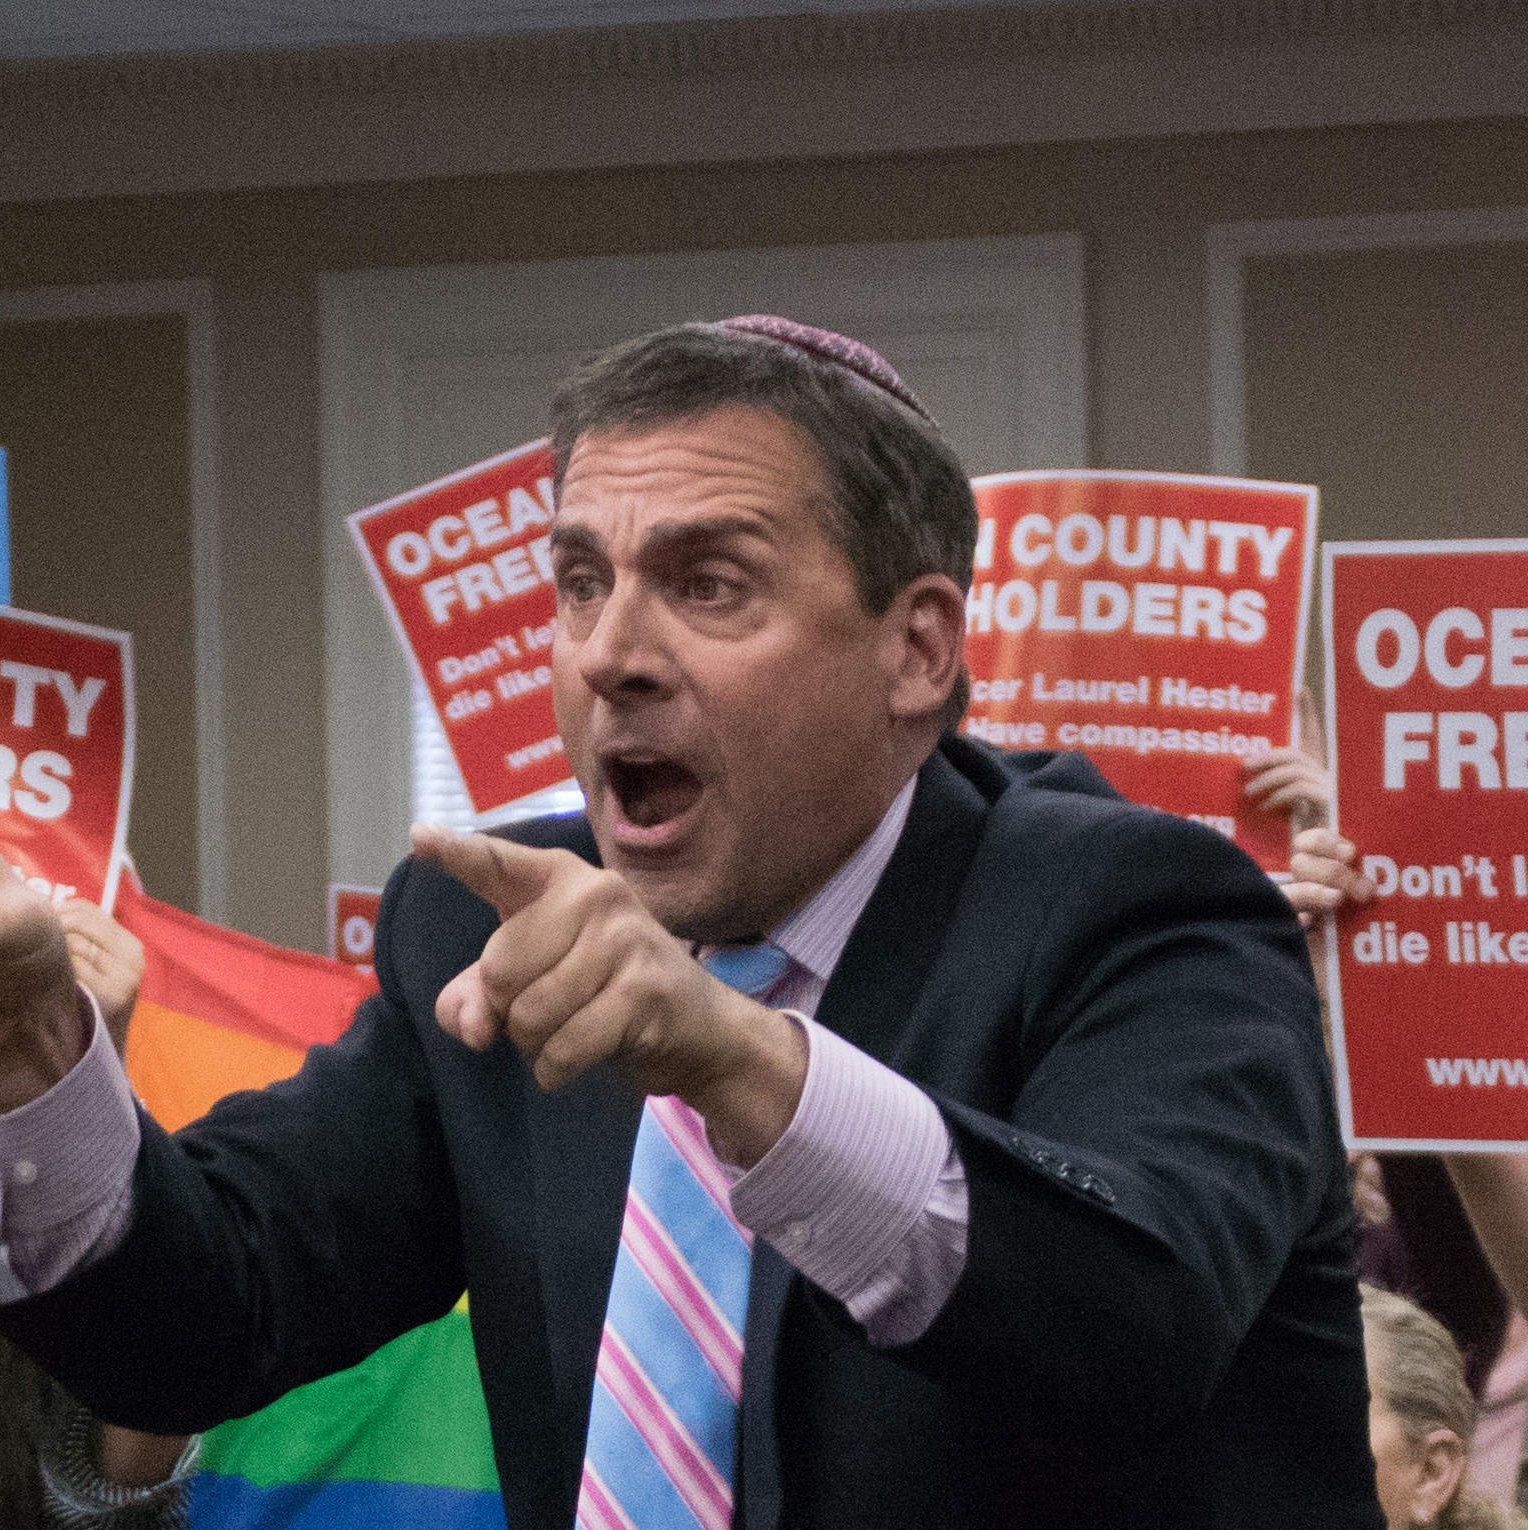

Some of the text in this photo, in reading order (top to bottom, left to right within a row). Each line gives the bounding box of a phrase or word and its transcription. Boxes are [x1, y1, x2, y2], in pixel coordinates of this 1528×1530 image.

[1010, 513, 1294, 579] COUNTY
[437, 635, 520, 685] Don't
[445, 665, 552, 720] die like
[1032, 672, 1150, 705] Laurel
[1159, 677, 1276, 714] Hester
[1362, 853, 1497, 898] Don't
[1353, 920, 1430, 965] die
